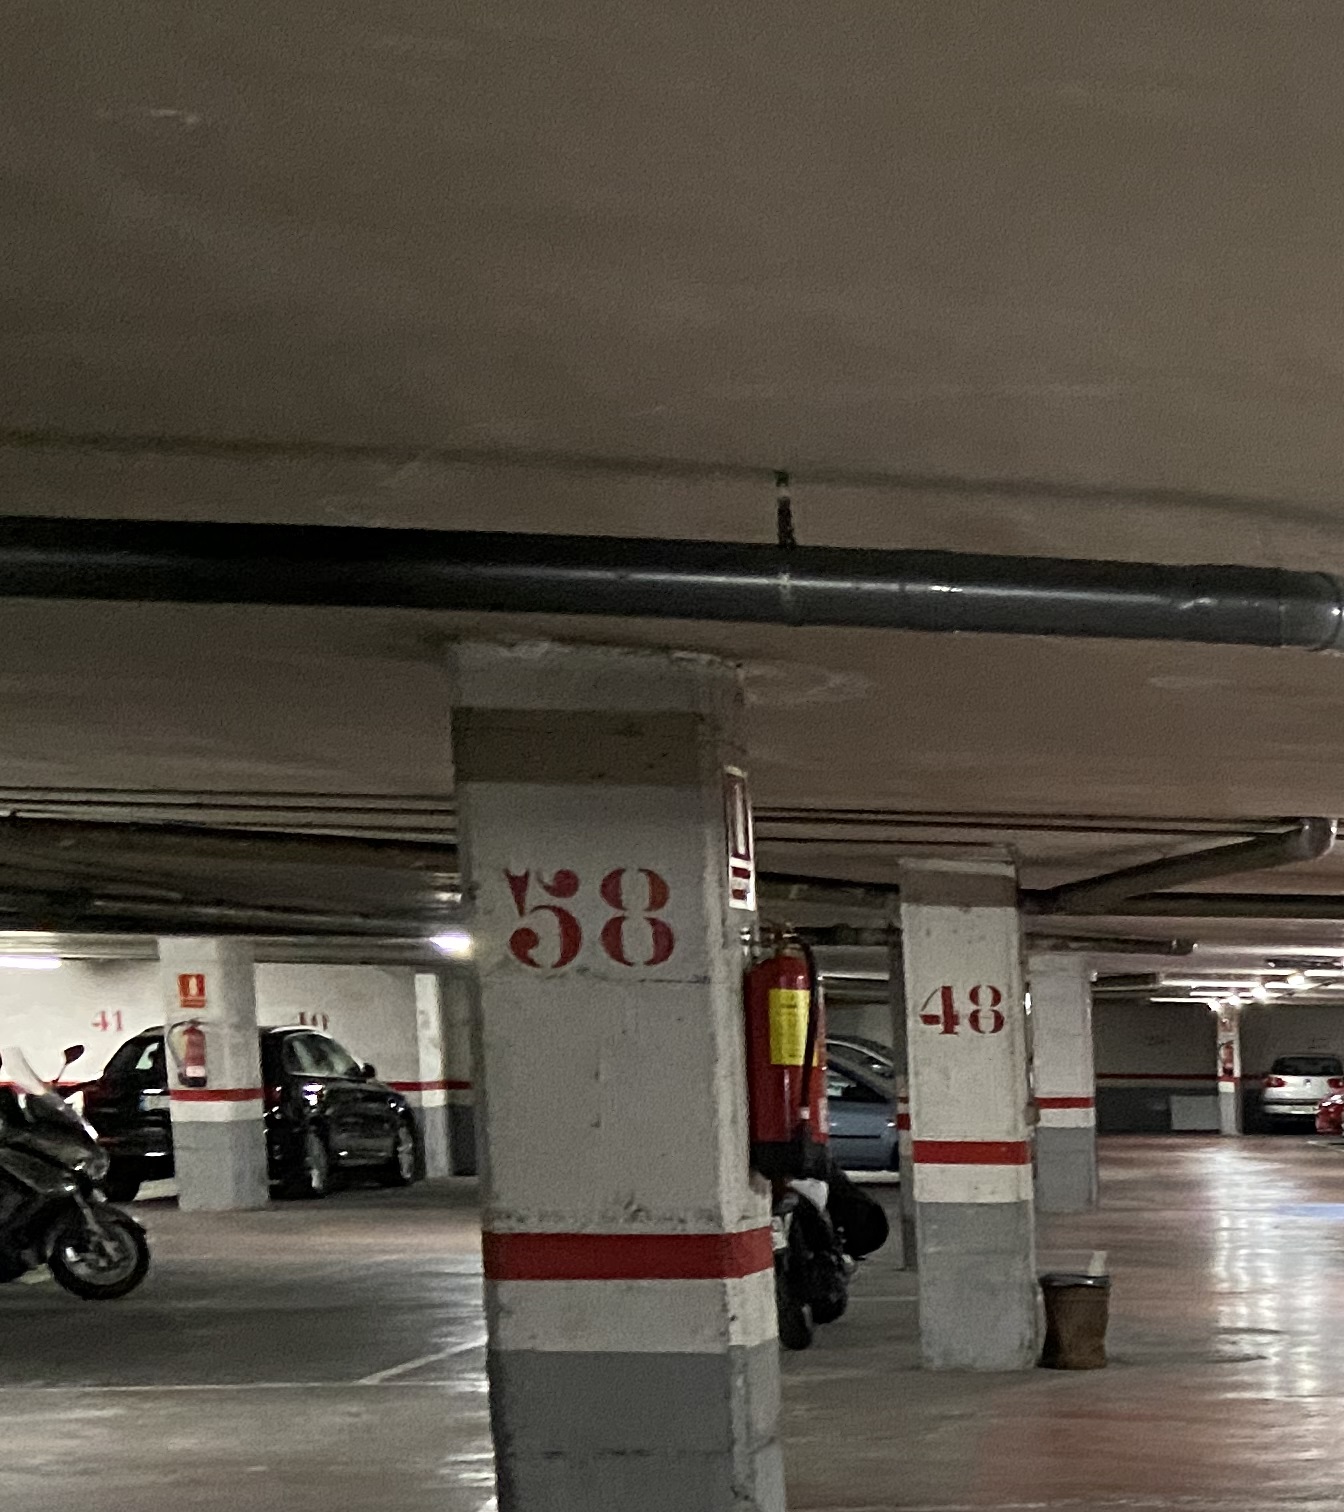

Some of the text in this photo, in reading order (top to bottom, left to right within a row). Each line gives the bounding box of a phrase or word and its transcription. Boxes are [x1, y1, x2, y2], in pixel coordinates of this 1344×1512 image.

[503, 868, 676, 968] 58
[91, 1010, 123, 1031] 41
[919, 985, 1004, 1034] 48
